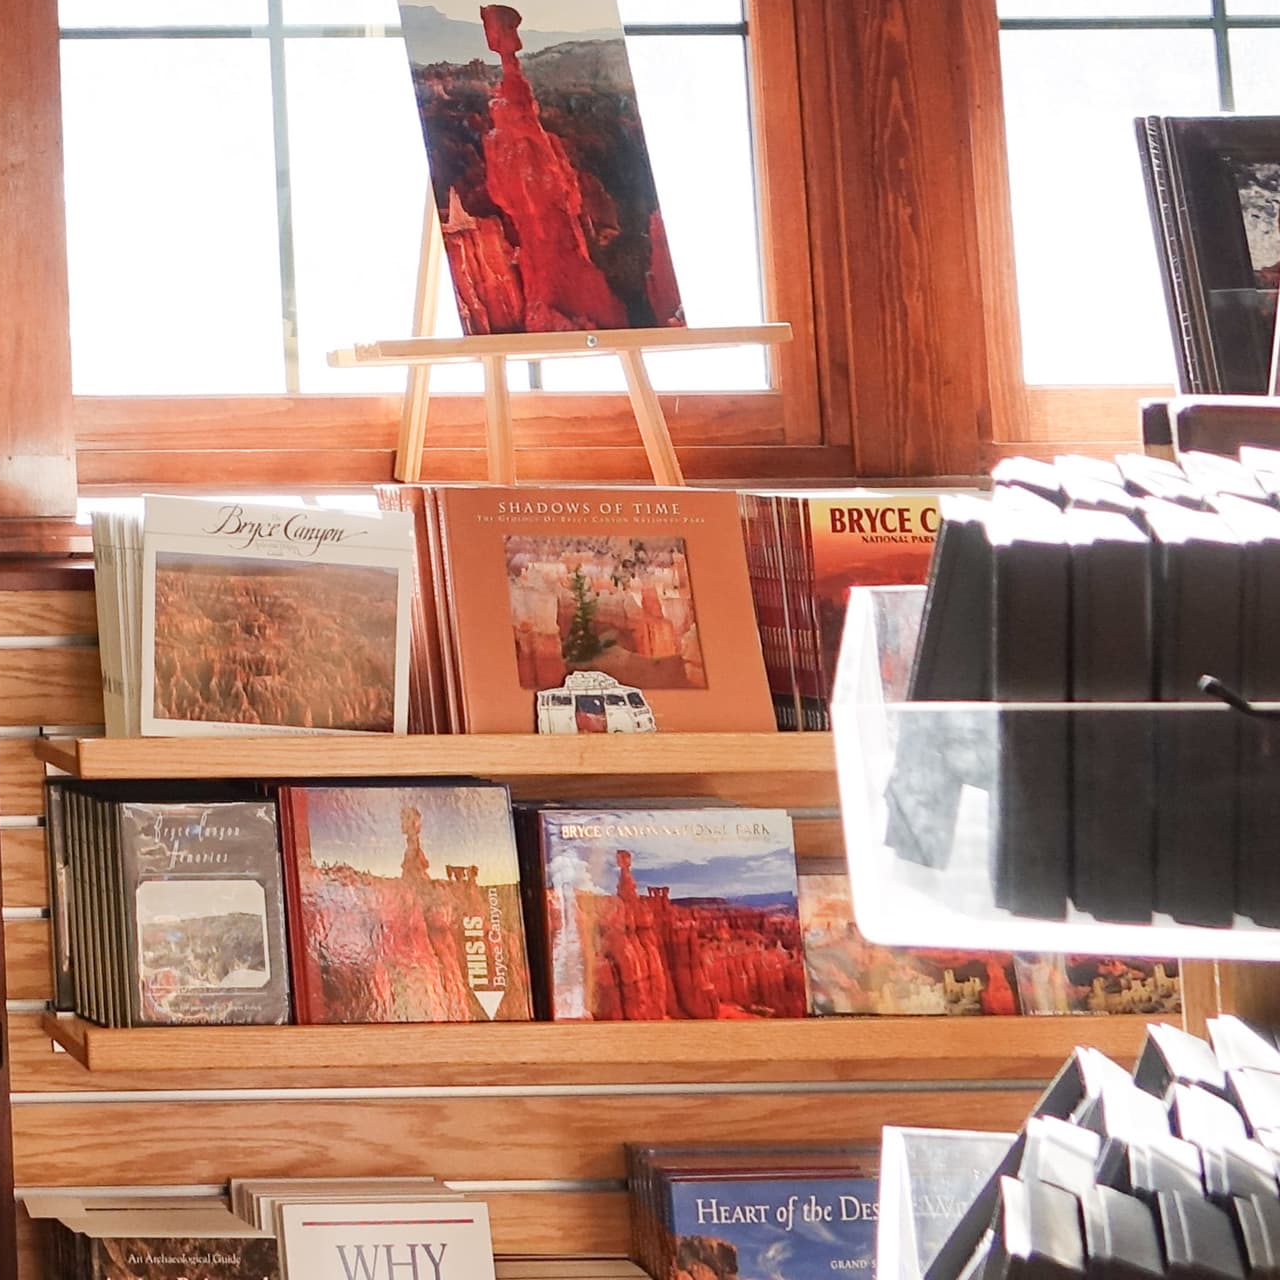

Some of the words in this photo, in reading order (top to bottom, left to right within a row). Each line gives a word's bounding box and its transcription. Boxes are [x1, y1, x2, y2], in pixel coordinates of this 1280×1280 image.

[498, 501, 591, 514] SHADOWS
[599, 502, 622, 514] OF
[632, 502, 681, 515] TIME
[829, 506, 913, 533] BRYCE
[203, 503, 281, 550] Bryce
[283, 512, 369, 557] Canyon
[861, 535, 909, 544] NATIONAL
[559, 824, 602, 839] BRYCE
[604, 824, 658, 838] CANYON
[662, 823, 728, 837] NATIONAL
[735, 823, 770, 837] PARK
[462, 915, 485, 937] IS
[488, 887, 503, 944] Canyon
[464, 940, 489, 989] THIS
[493, 945, 508, 987] Bryce
[695, 1198, 771, 1224] HEART
[775, 1195, 800, 1232] of
[802, 1195, 833, 1222] the
[128, 1253, 143, 1264] An
[144, 1252, 211, 1265] Archaeological
[211, 1252, 242, 1265] Guide
[335, 1243, 449, 1280] WHY
[830, 1259, 868, 1271] GRAND
